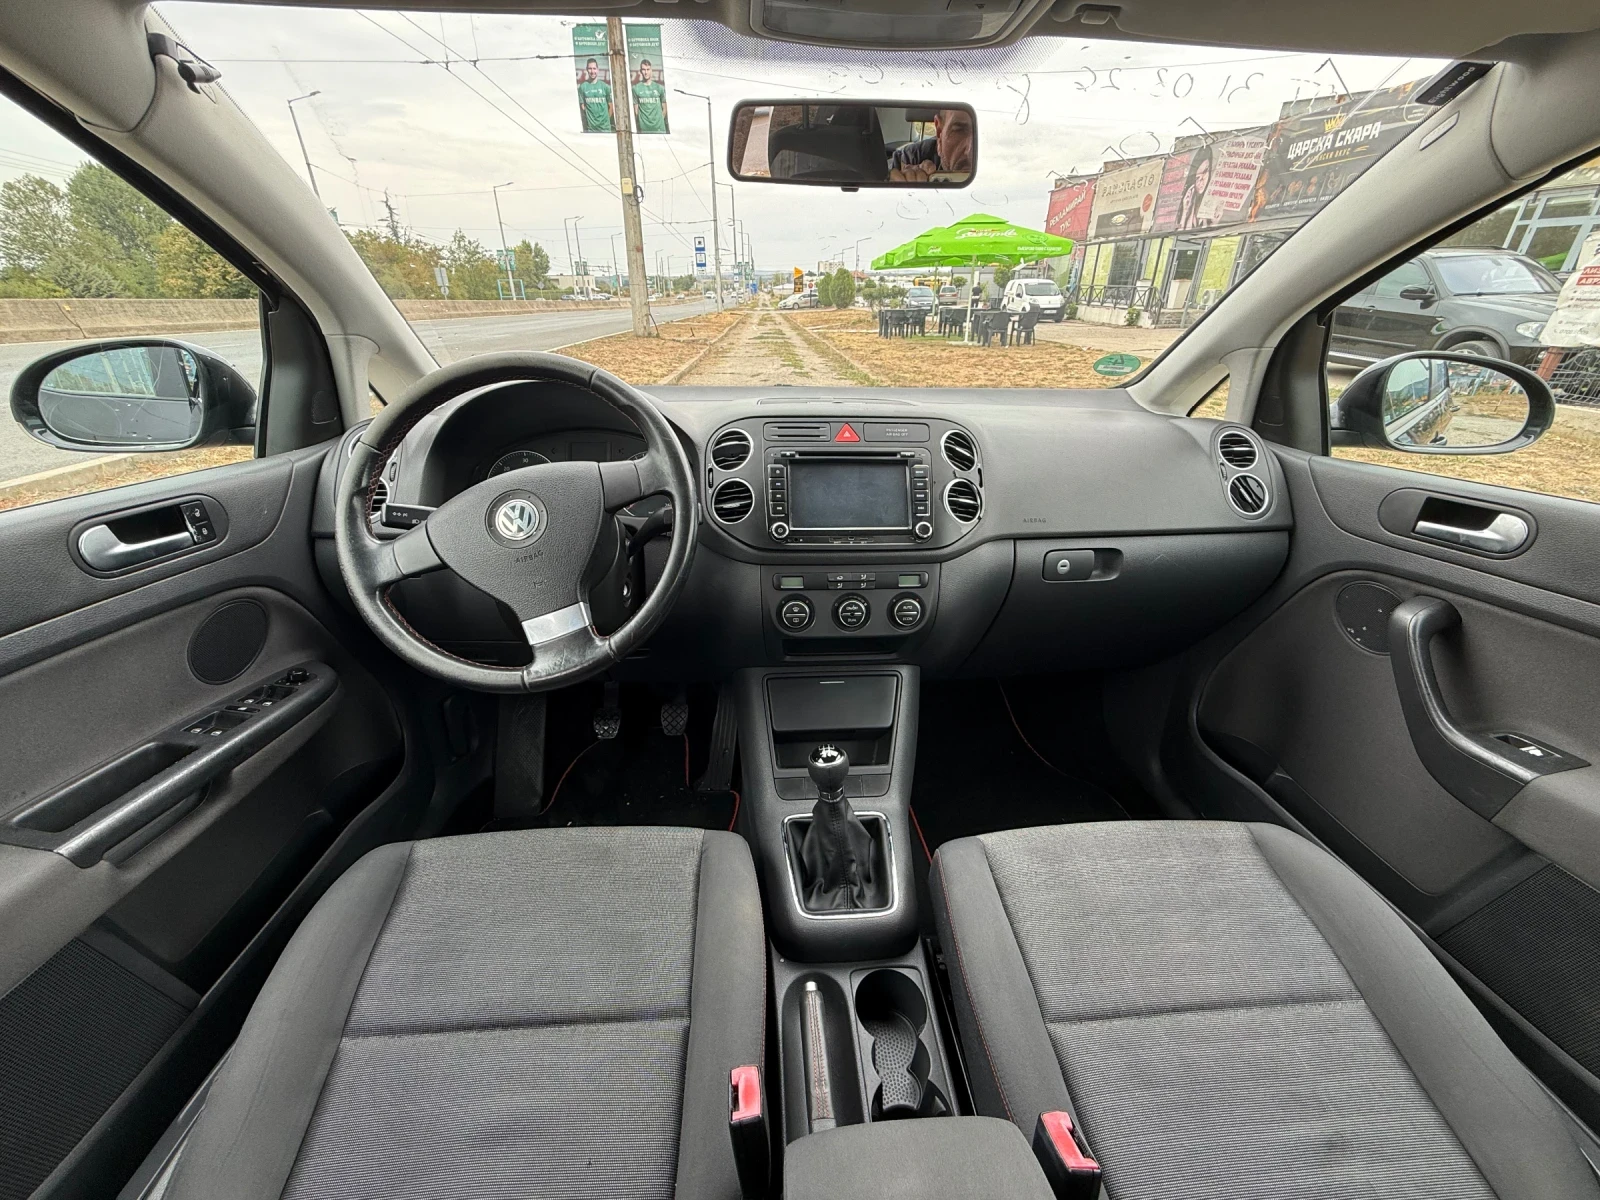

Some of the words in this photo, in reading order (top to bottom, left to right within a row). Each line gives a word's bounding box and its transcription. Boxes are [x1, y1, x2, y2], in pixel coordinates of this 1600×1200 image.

[1287, 134, 1334, 160] ЦАРСКА
[1334, 121, 1382, 148] СКАРА
[515, 551, 545, 564] AIRBAG
